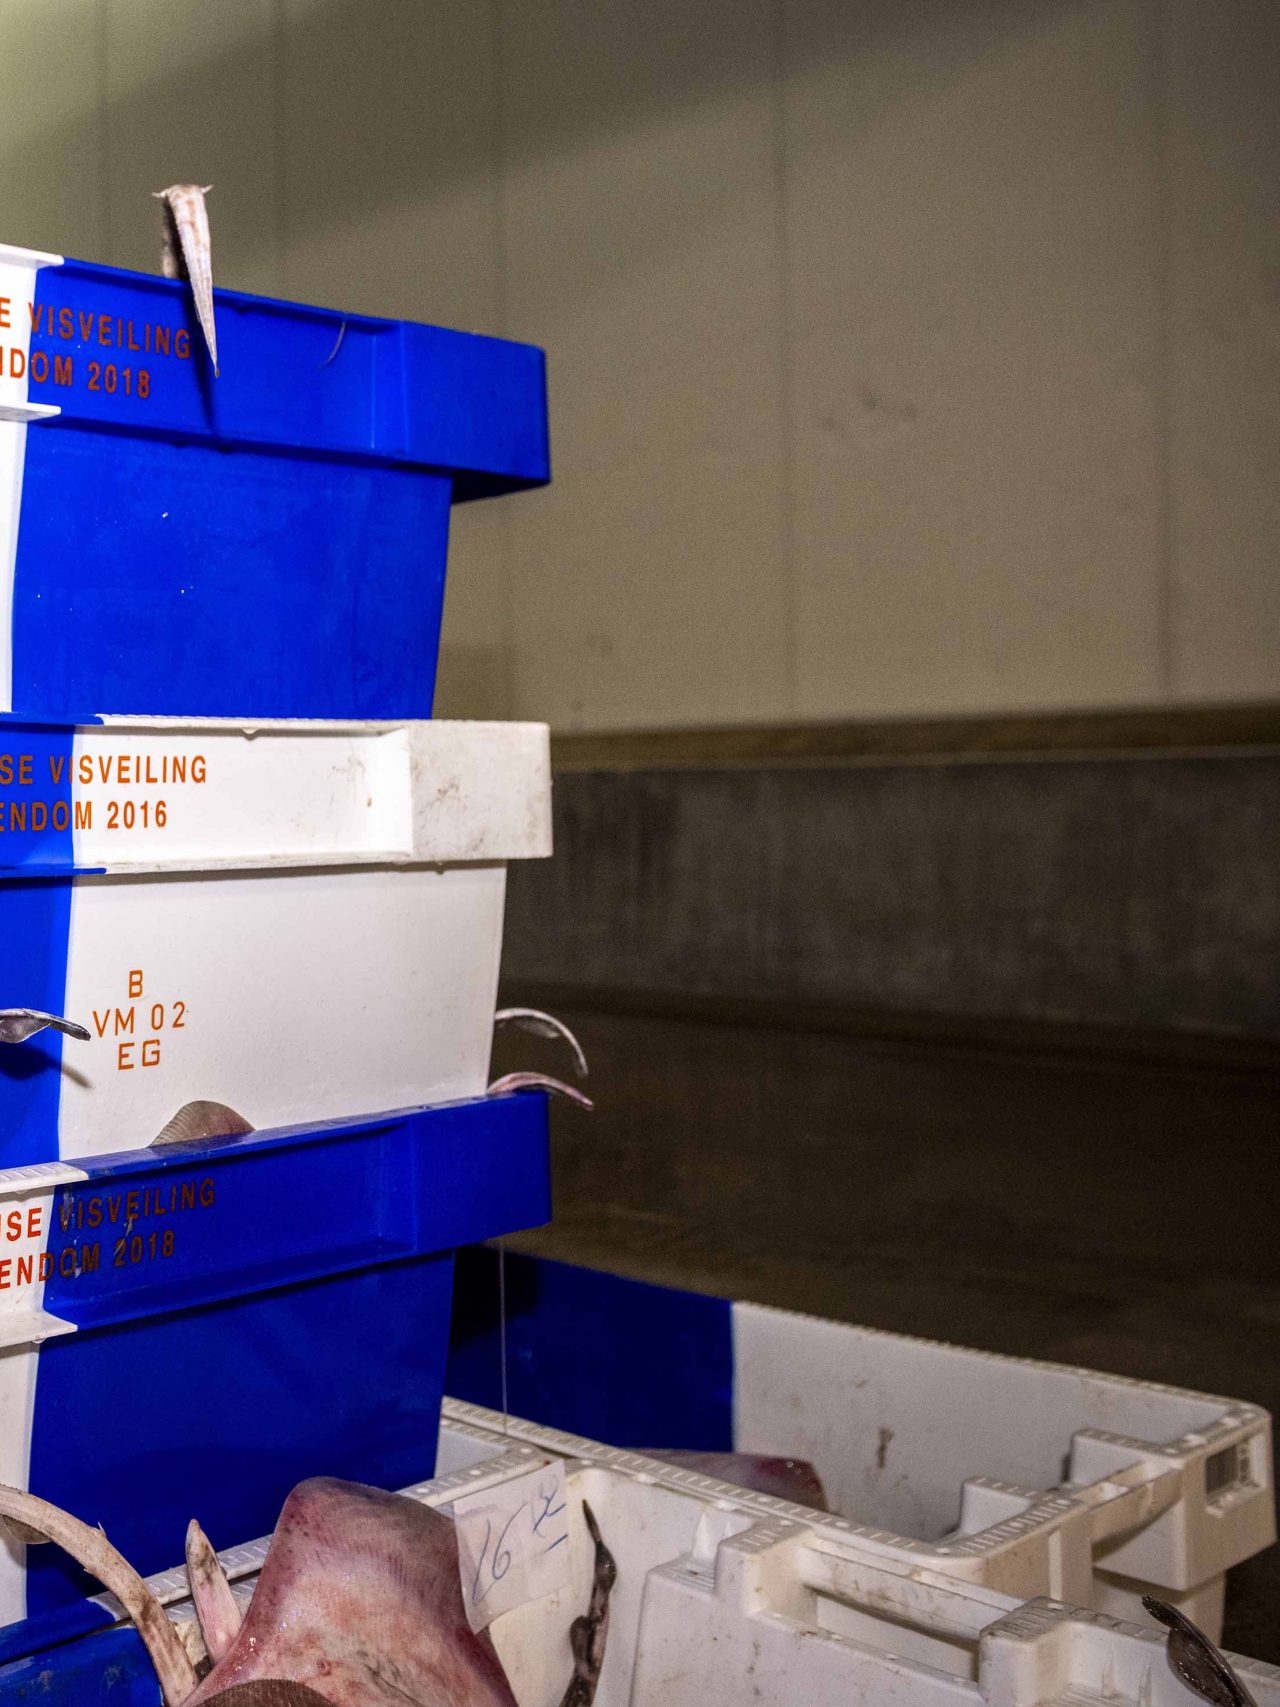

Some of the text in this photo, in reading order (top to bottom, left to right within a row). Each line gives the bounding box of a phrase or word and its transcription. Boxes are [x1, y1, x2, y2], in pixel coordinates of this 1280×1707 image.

[28, 302, 191, 360] VISVEILING
[88, 361, 150, 399] 2018
[49, 754, 207, 785] VISVEILING
[106, 800, 168, 830] 2016
[128, 969, 144, 999] B
[92, 1006, 135, 1039] VM
[118, 1038, 161, 1071] EG
[58, 1178, 217, 1233] VISVEILING
[113, 1230, 176, 1267] 2018
